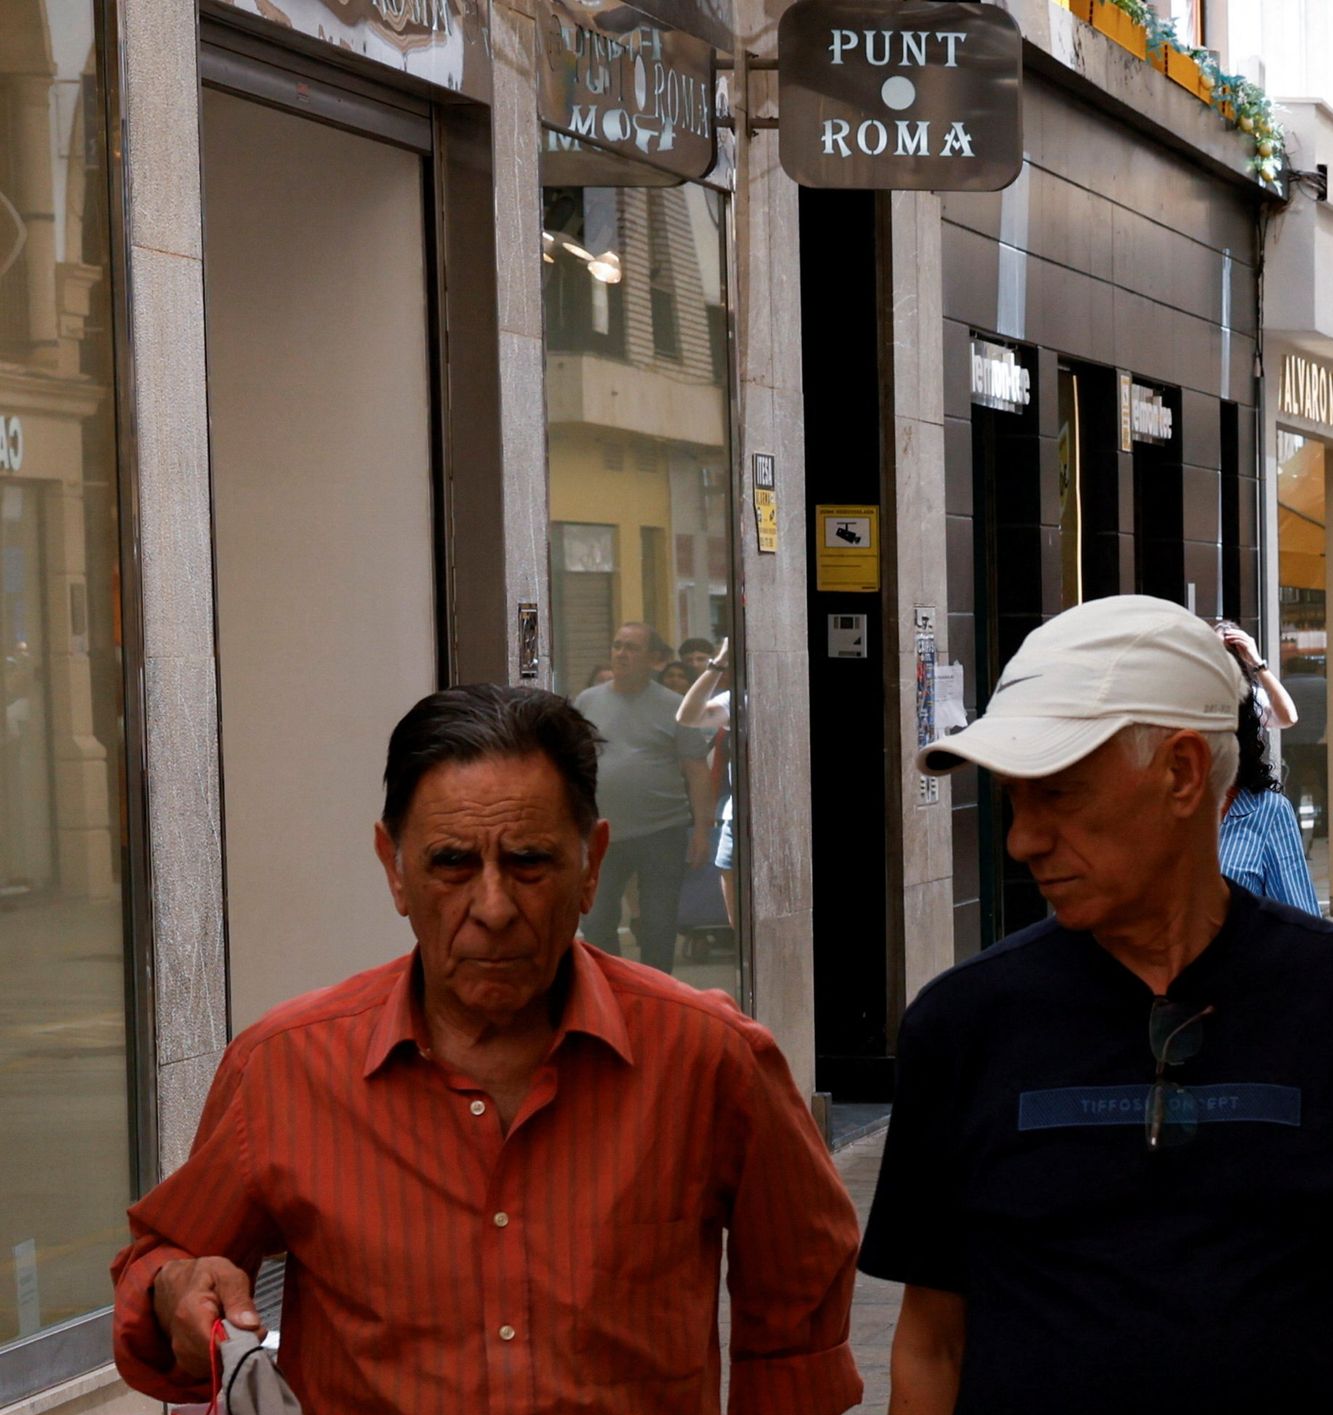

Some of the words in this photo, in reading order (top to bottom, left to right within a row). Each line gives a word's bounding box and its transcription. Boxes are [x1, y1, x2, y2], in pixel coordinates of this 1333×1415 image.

[828, 28, 968, 68] PUNT
[820, 118, 976, 158] ROMA
[1080, 1099, 1148, 1114] TIFFOS
